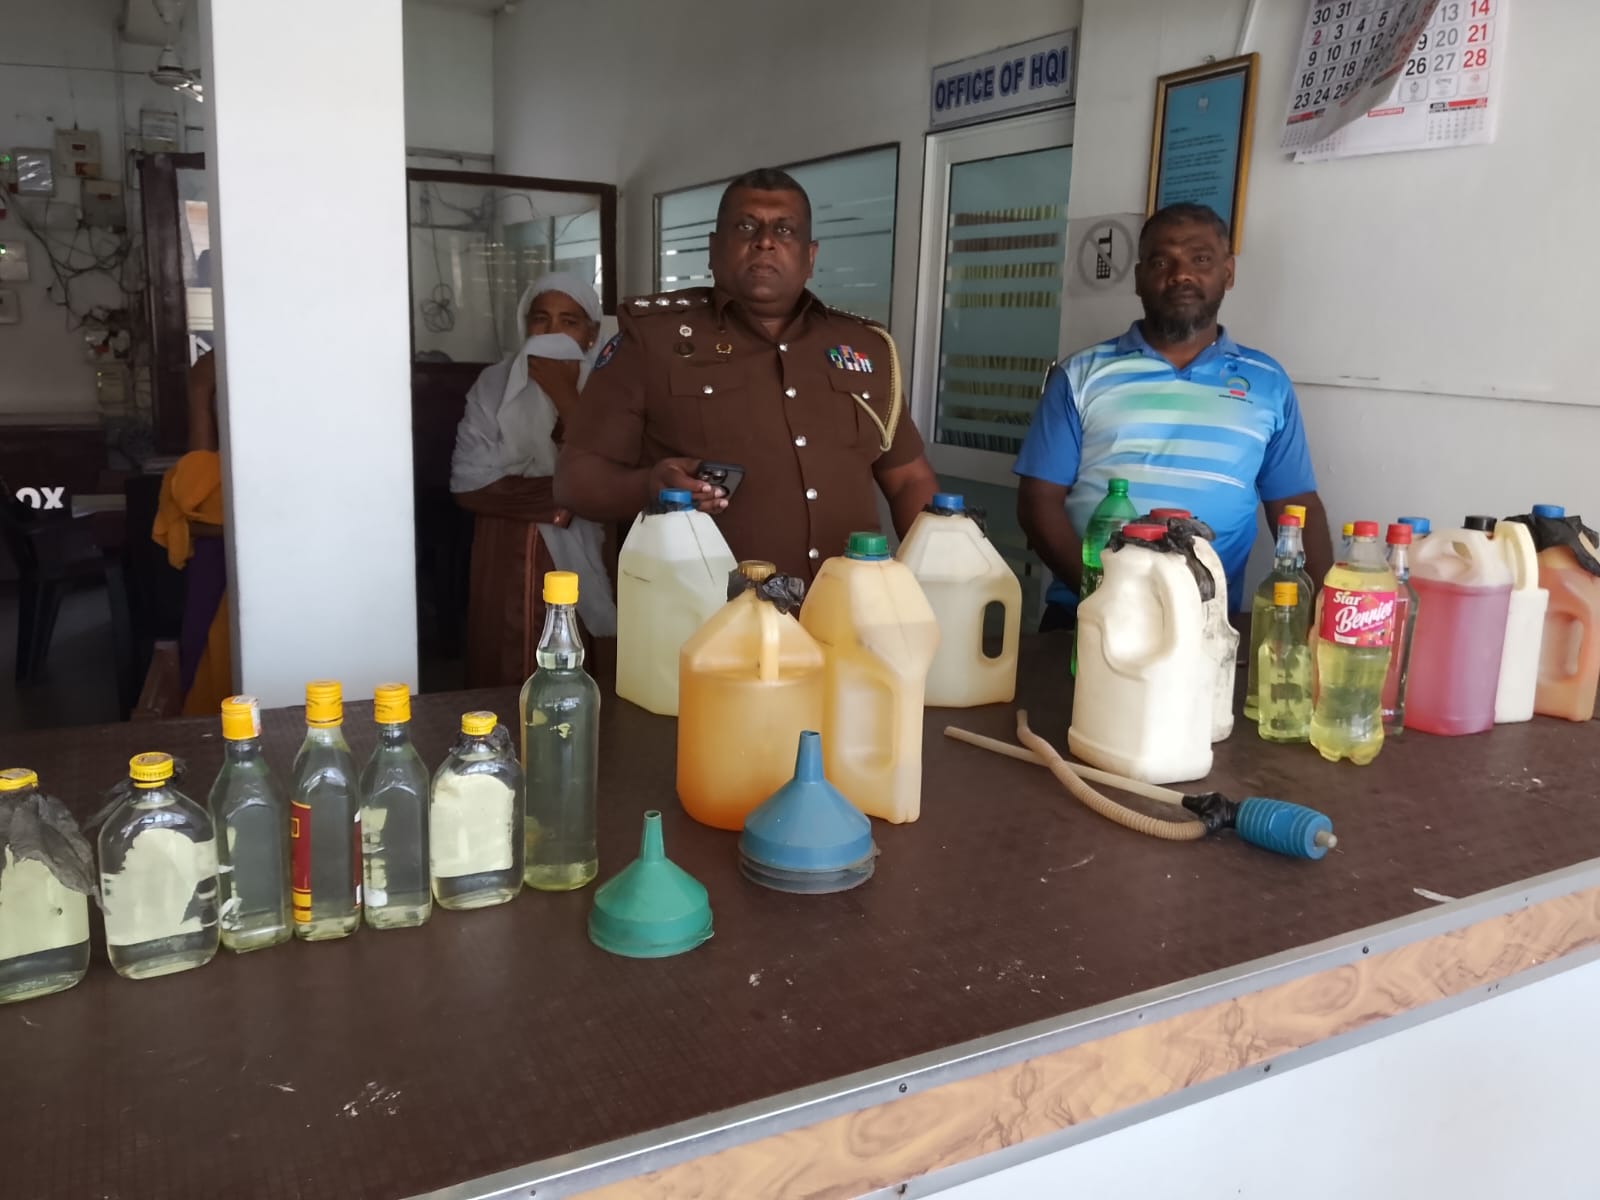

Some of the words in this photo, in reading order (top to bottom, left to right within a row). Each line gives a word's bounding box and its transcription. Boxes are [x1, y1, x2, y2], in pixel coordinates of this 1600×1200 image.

[1312, 7, 1331, 26] 30
[1335, 0, 1352, 19] 31
[1441, 3, 1459, 23] 13
[1470, 0, 1490, 18] 14
[1311, 29, 1322, 46] 2
[1334, 23, 1344, 40] 3
[1356, 17, 1366, 33] 4
[1378, 10, 1389, 28] 5
[1434, 27, 1459, 48] 20
[1467, 23, 1488, 43] 21
[1308, 50, 1317, 67] 9
[1327, 44, 1341, 62] 10
[1350, 39, 1362, 56] 11
[1369, 32, 1384, 50] 12
[1405, 56, 1427, 76] 26
[1433, 52, 1457, 72] 27
[1463, 48, 1487, 68] 28
[934, 66, 996, 112] OFFICE
[1000, 58, 1025, 96] OF
[1029, 46, 1069, 90] HQI
[1301, 71, 1315, 88] 16
[1322, 66, 1336, 83] 17
[1341, 60, 1356, 78] 18
[1293, 92, 1311, 110] 23
[1313, 87, 1330, 105] 24
[1333, 81, 1351, 100] 25
[1332, 591, 1362, 606] Star
